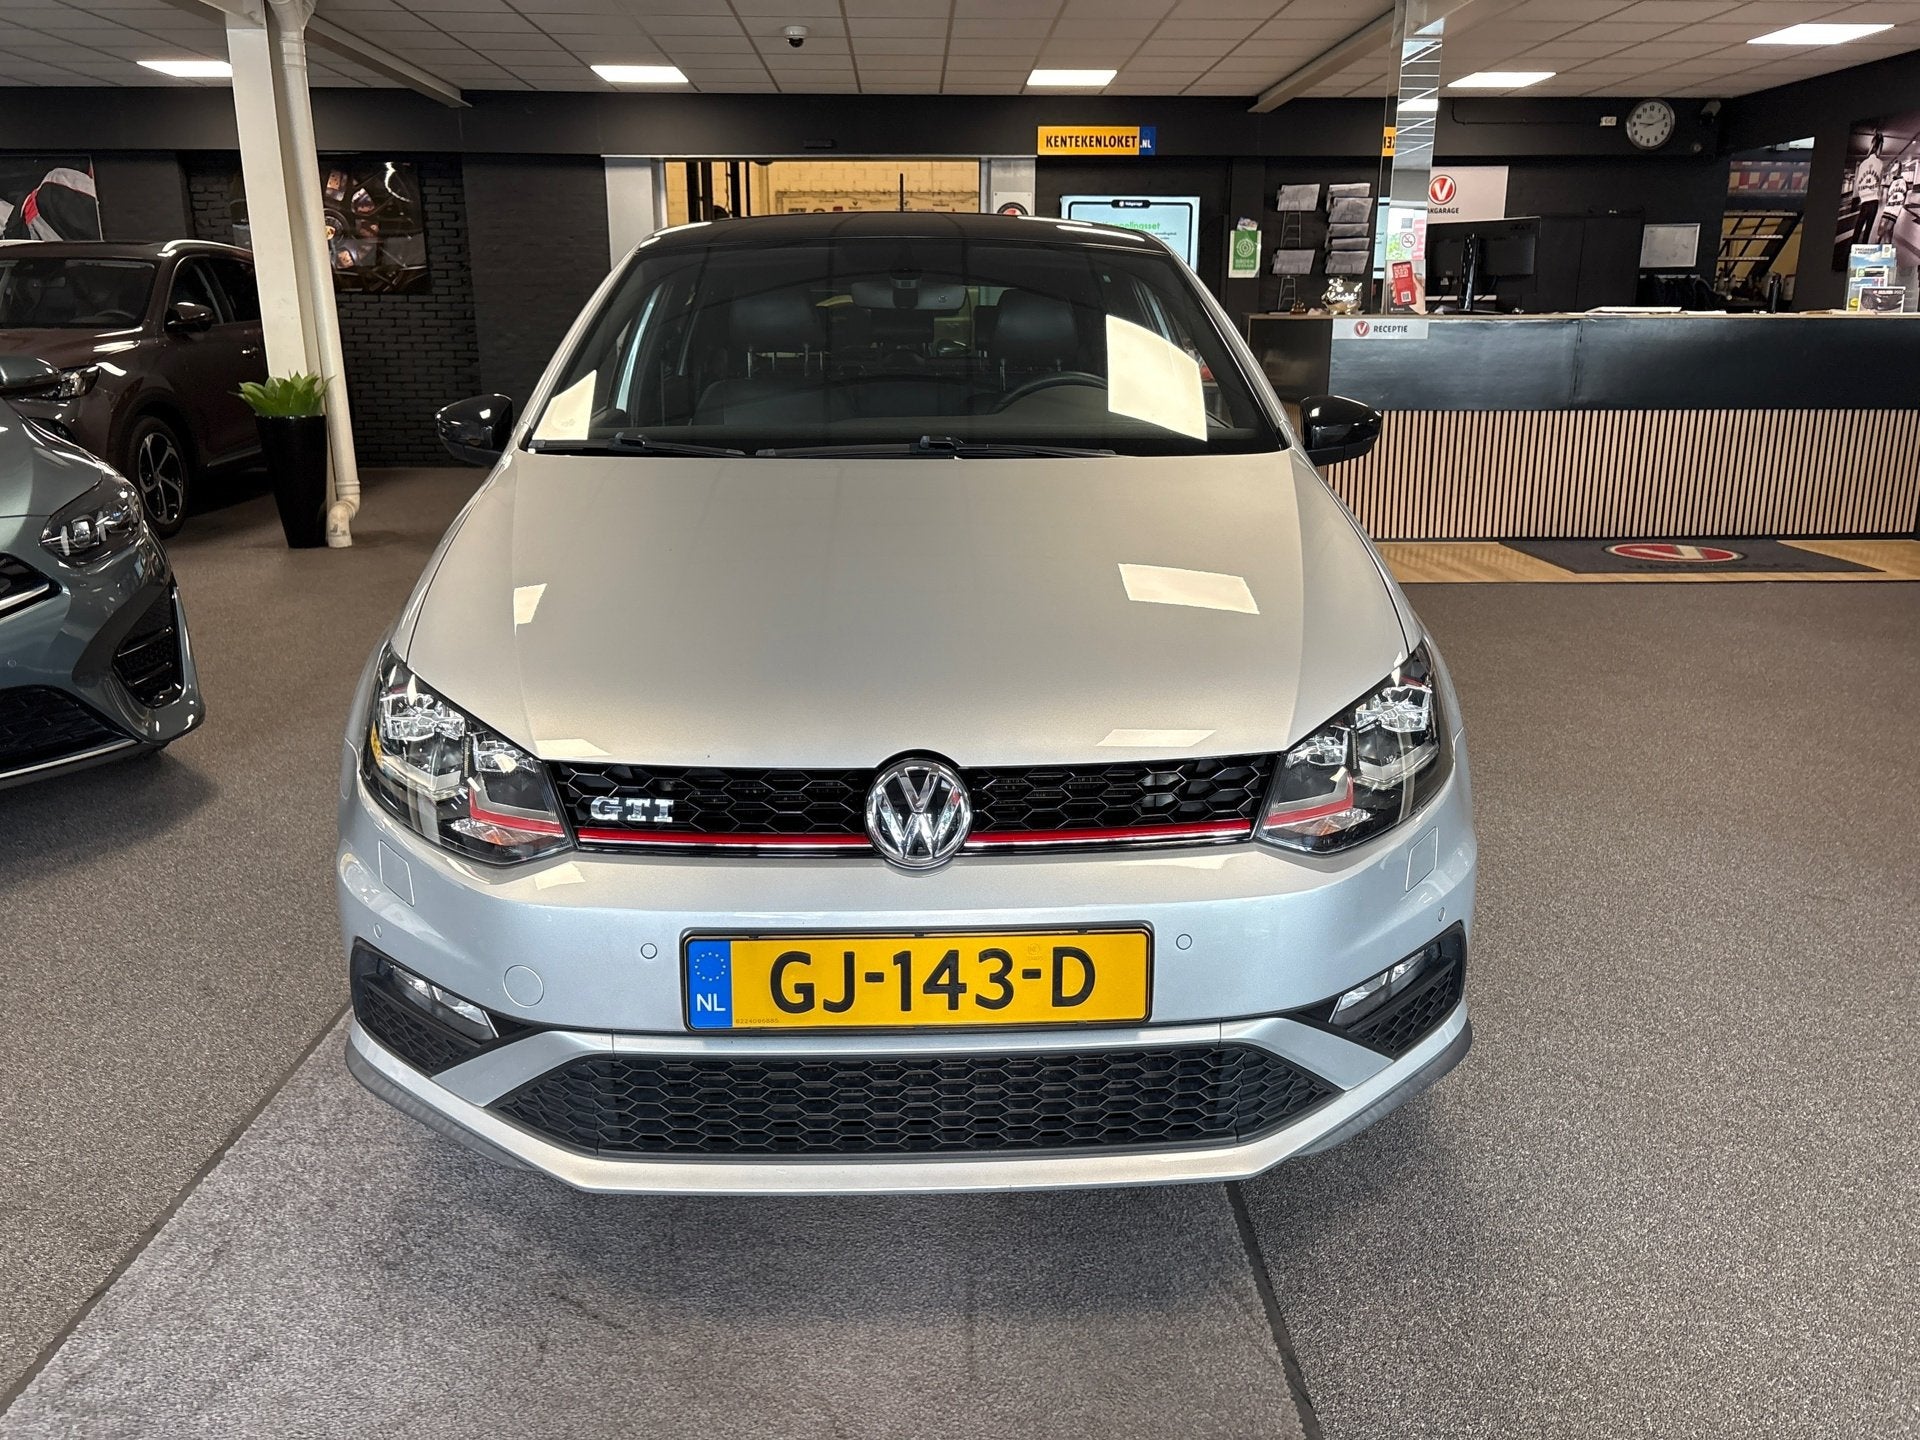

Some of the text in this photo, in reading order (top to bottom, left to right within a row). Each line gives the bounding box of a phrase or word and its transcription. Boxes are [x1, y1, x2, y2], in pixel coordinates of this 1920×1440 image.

[1046, 135, 1137, 148] KENTEKENLOKET
[1373, 325, 1408, 333] RECEPTIE
[590, 796, 674, 822] GTI
[770, 946, 1096, 1014] GJ-143-D
[696, 993, 726, 1012] NL
